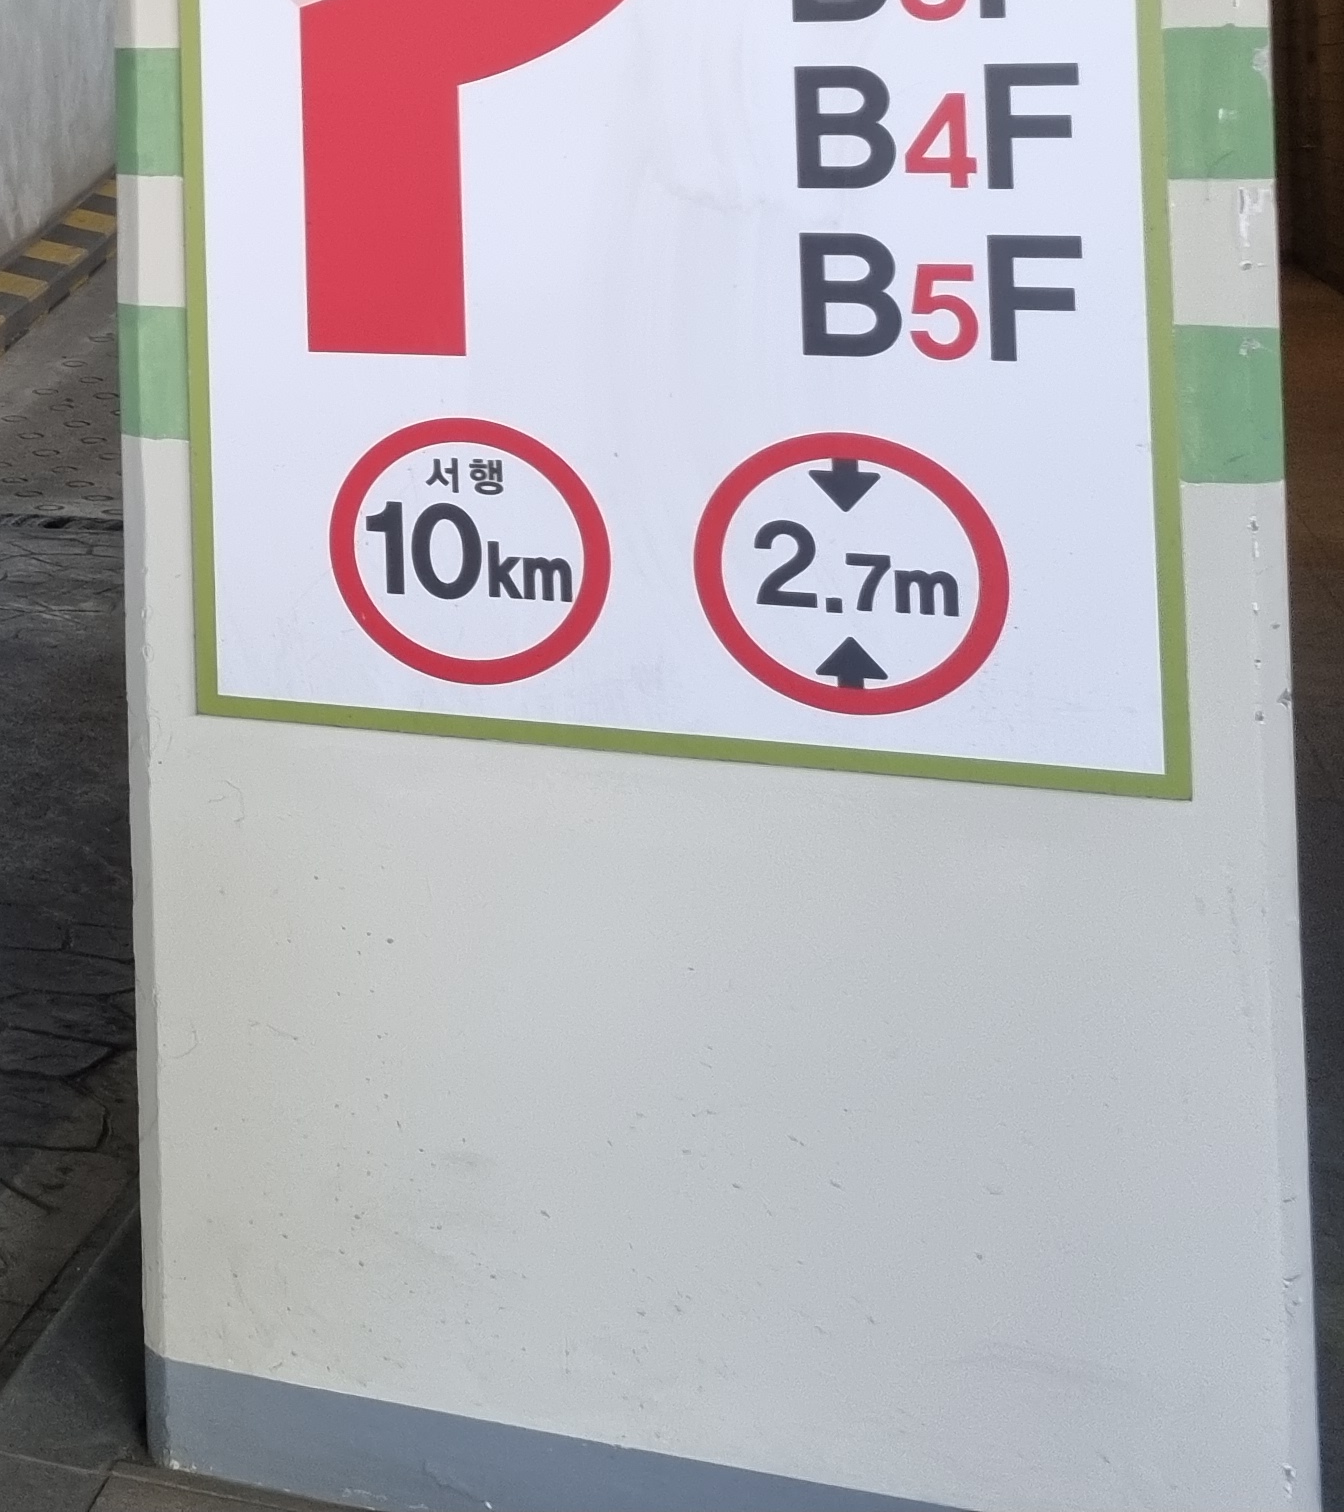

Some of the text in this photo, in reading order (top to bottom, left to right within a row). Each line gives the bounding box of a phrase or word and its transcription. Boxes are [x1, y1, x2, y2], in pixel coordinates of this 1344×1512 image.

[794, 62, 1080, 190] B4F
[799, 232, 1083, 362] B5F
[365, 502, 573, 602] 10km
[753, 520, 960, 617] 2.7m
